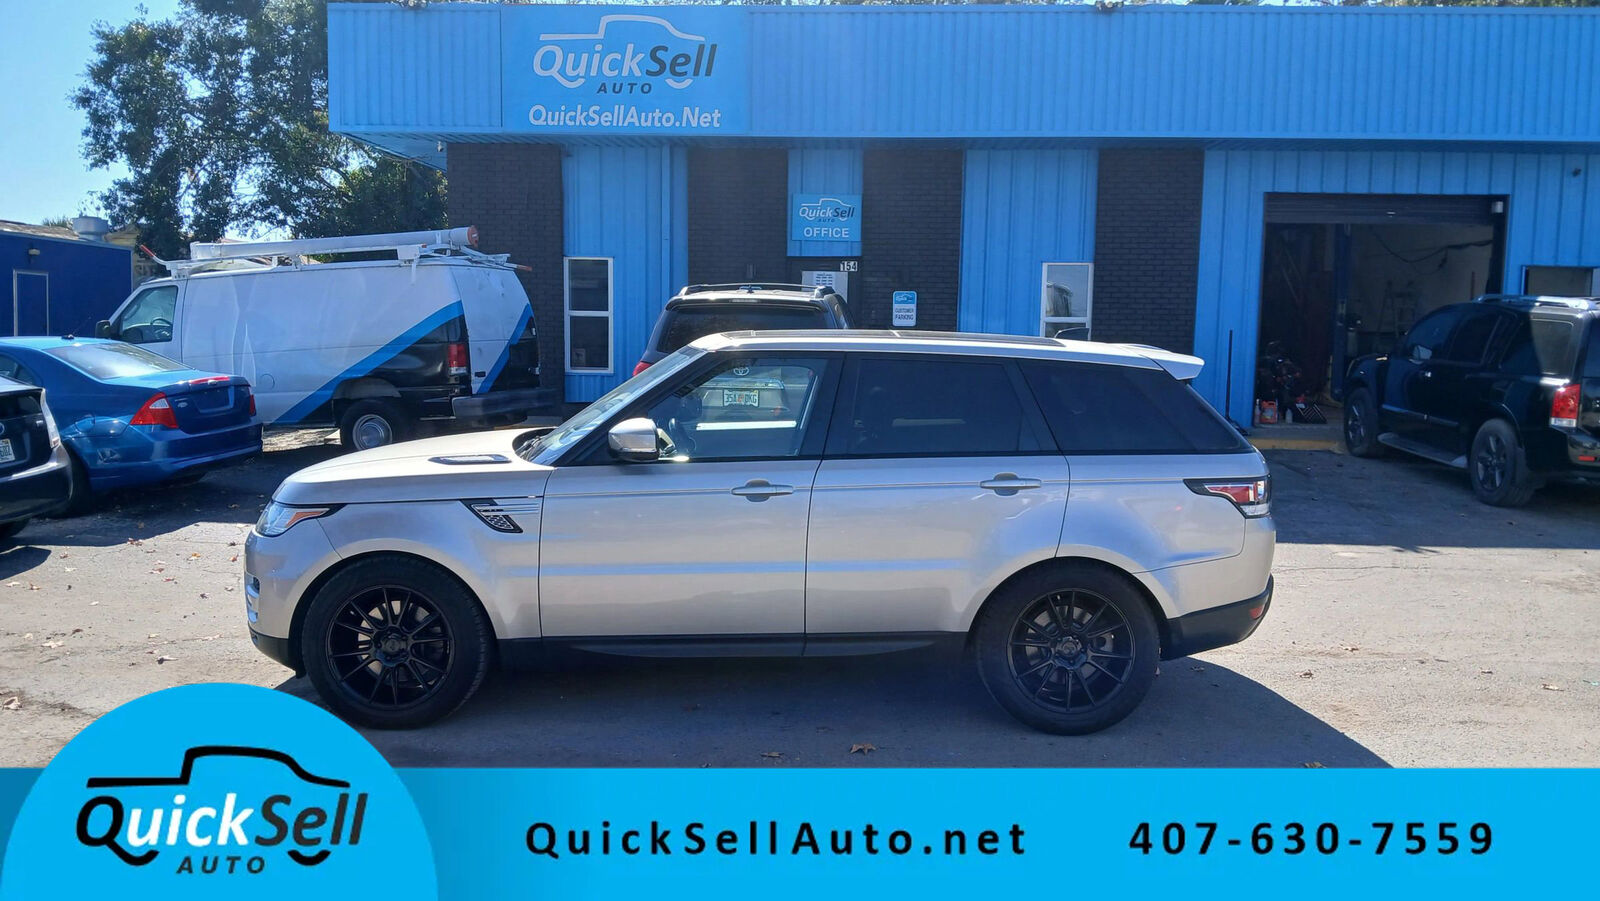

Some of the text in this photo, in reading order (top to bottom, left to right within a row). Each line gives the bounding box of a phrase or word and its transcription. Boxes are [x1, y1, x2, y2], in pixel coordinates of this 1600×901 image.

[533, 43, 718, 89] QuickSell
[597, 82, 652, 95] AUTO
[528, 104, 721, 128] QuickSellAuto.Net
[799, 206, 855, 221] QuickSell
[803, 227, 850, 238] OFFICE
[841, 262, 857, 271] 154
